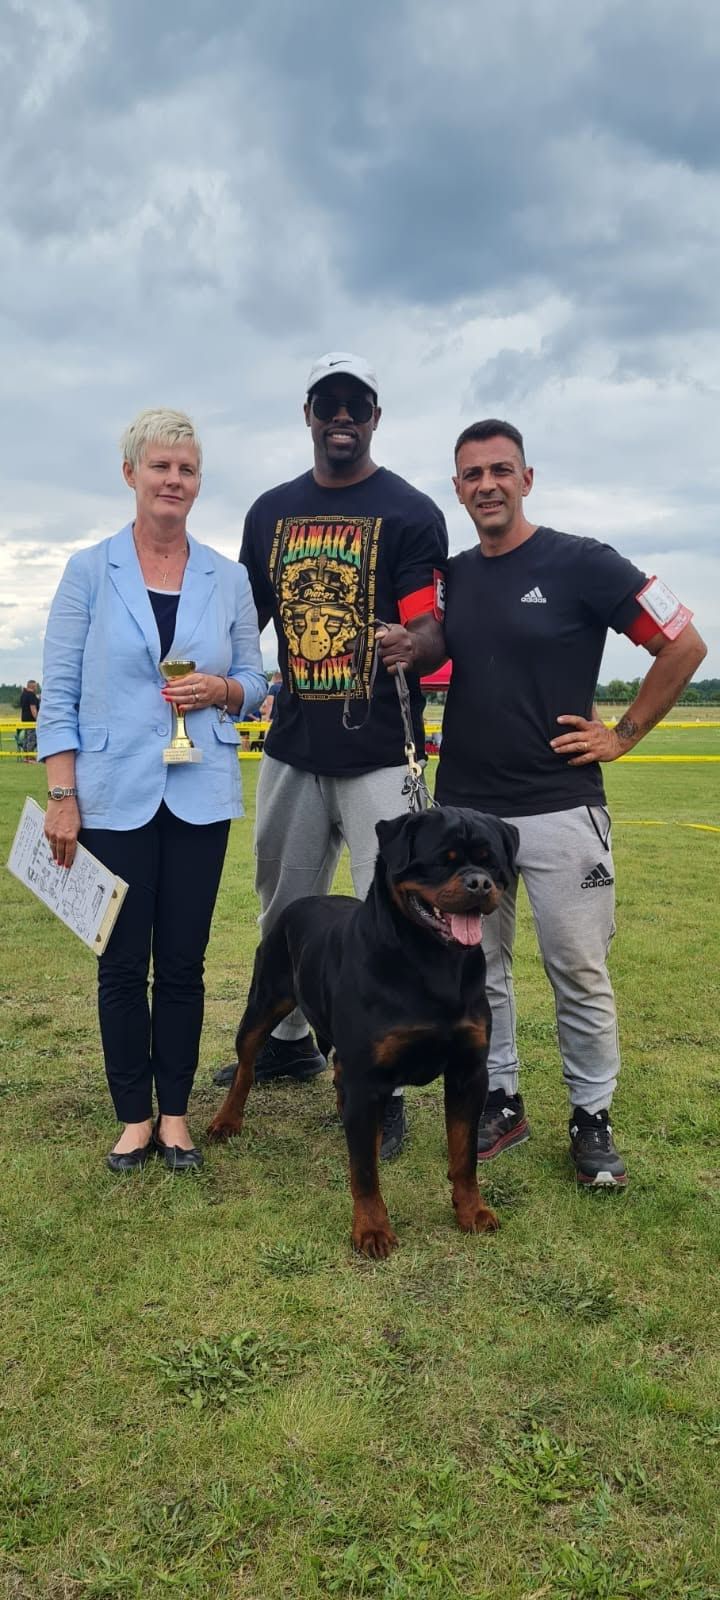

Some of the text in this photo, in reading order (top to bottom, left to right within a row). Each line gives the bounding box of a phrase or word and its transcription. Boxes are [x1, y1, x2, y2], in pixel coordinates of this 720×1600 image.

[283, 525, 362, 570] JAMAICA
[520, 596, 547, 604] adidas
[291, 656, 310, 690] NE
[313, 653, 356, 690] LOVE
